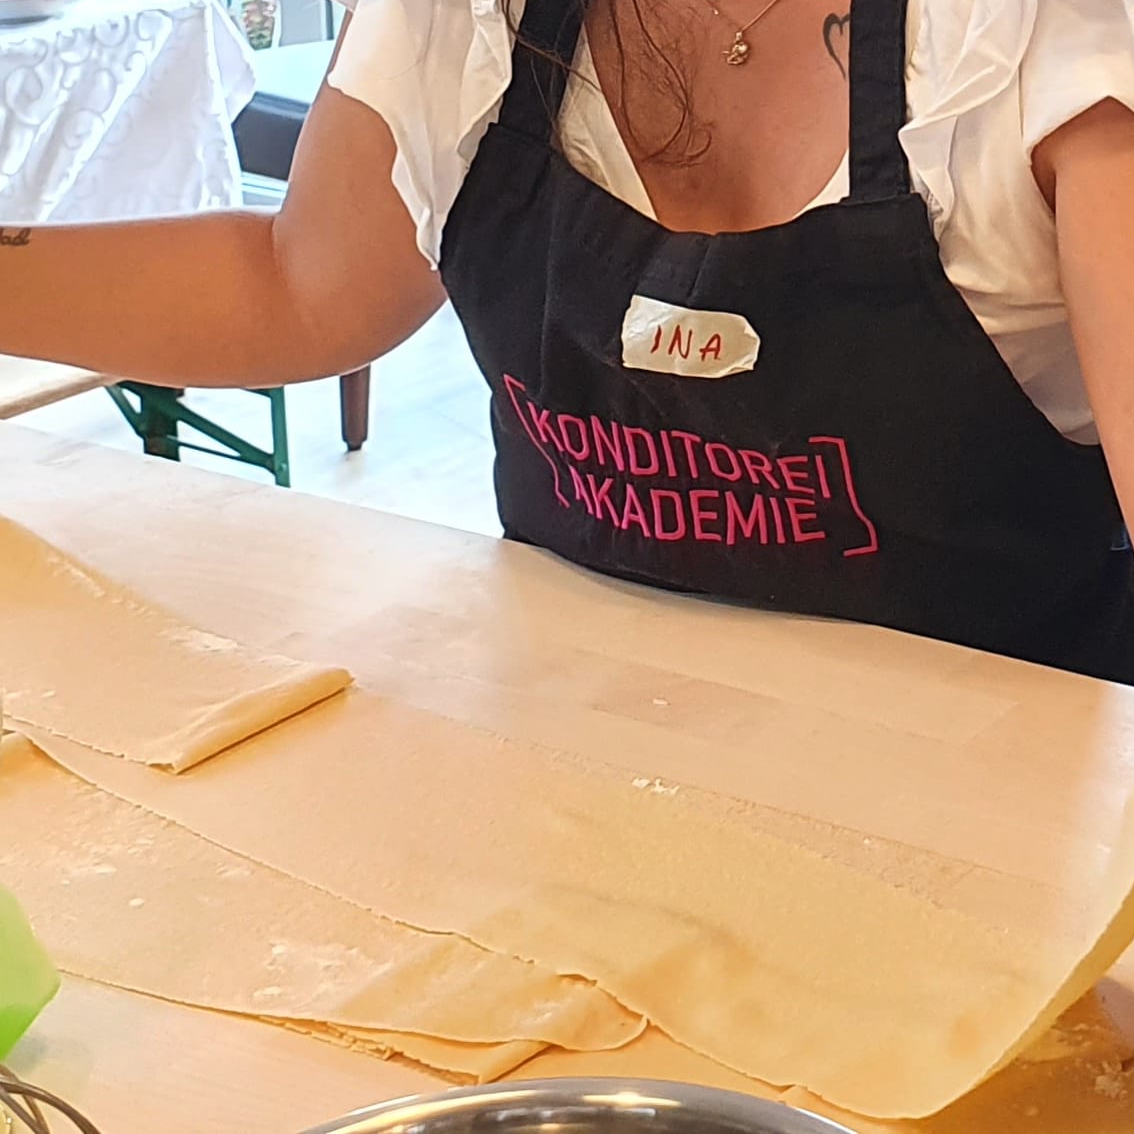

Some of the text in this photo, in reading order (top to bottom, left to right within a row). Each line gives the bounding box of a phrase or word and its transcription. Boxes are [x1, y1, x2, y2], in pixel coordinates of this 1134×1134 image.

[650, 324, 723, 361] INA
[525, 401, 831, 499] KONDITOREI
[568, 464, 826, 546] AKADEMIE
